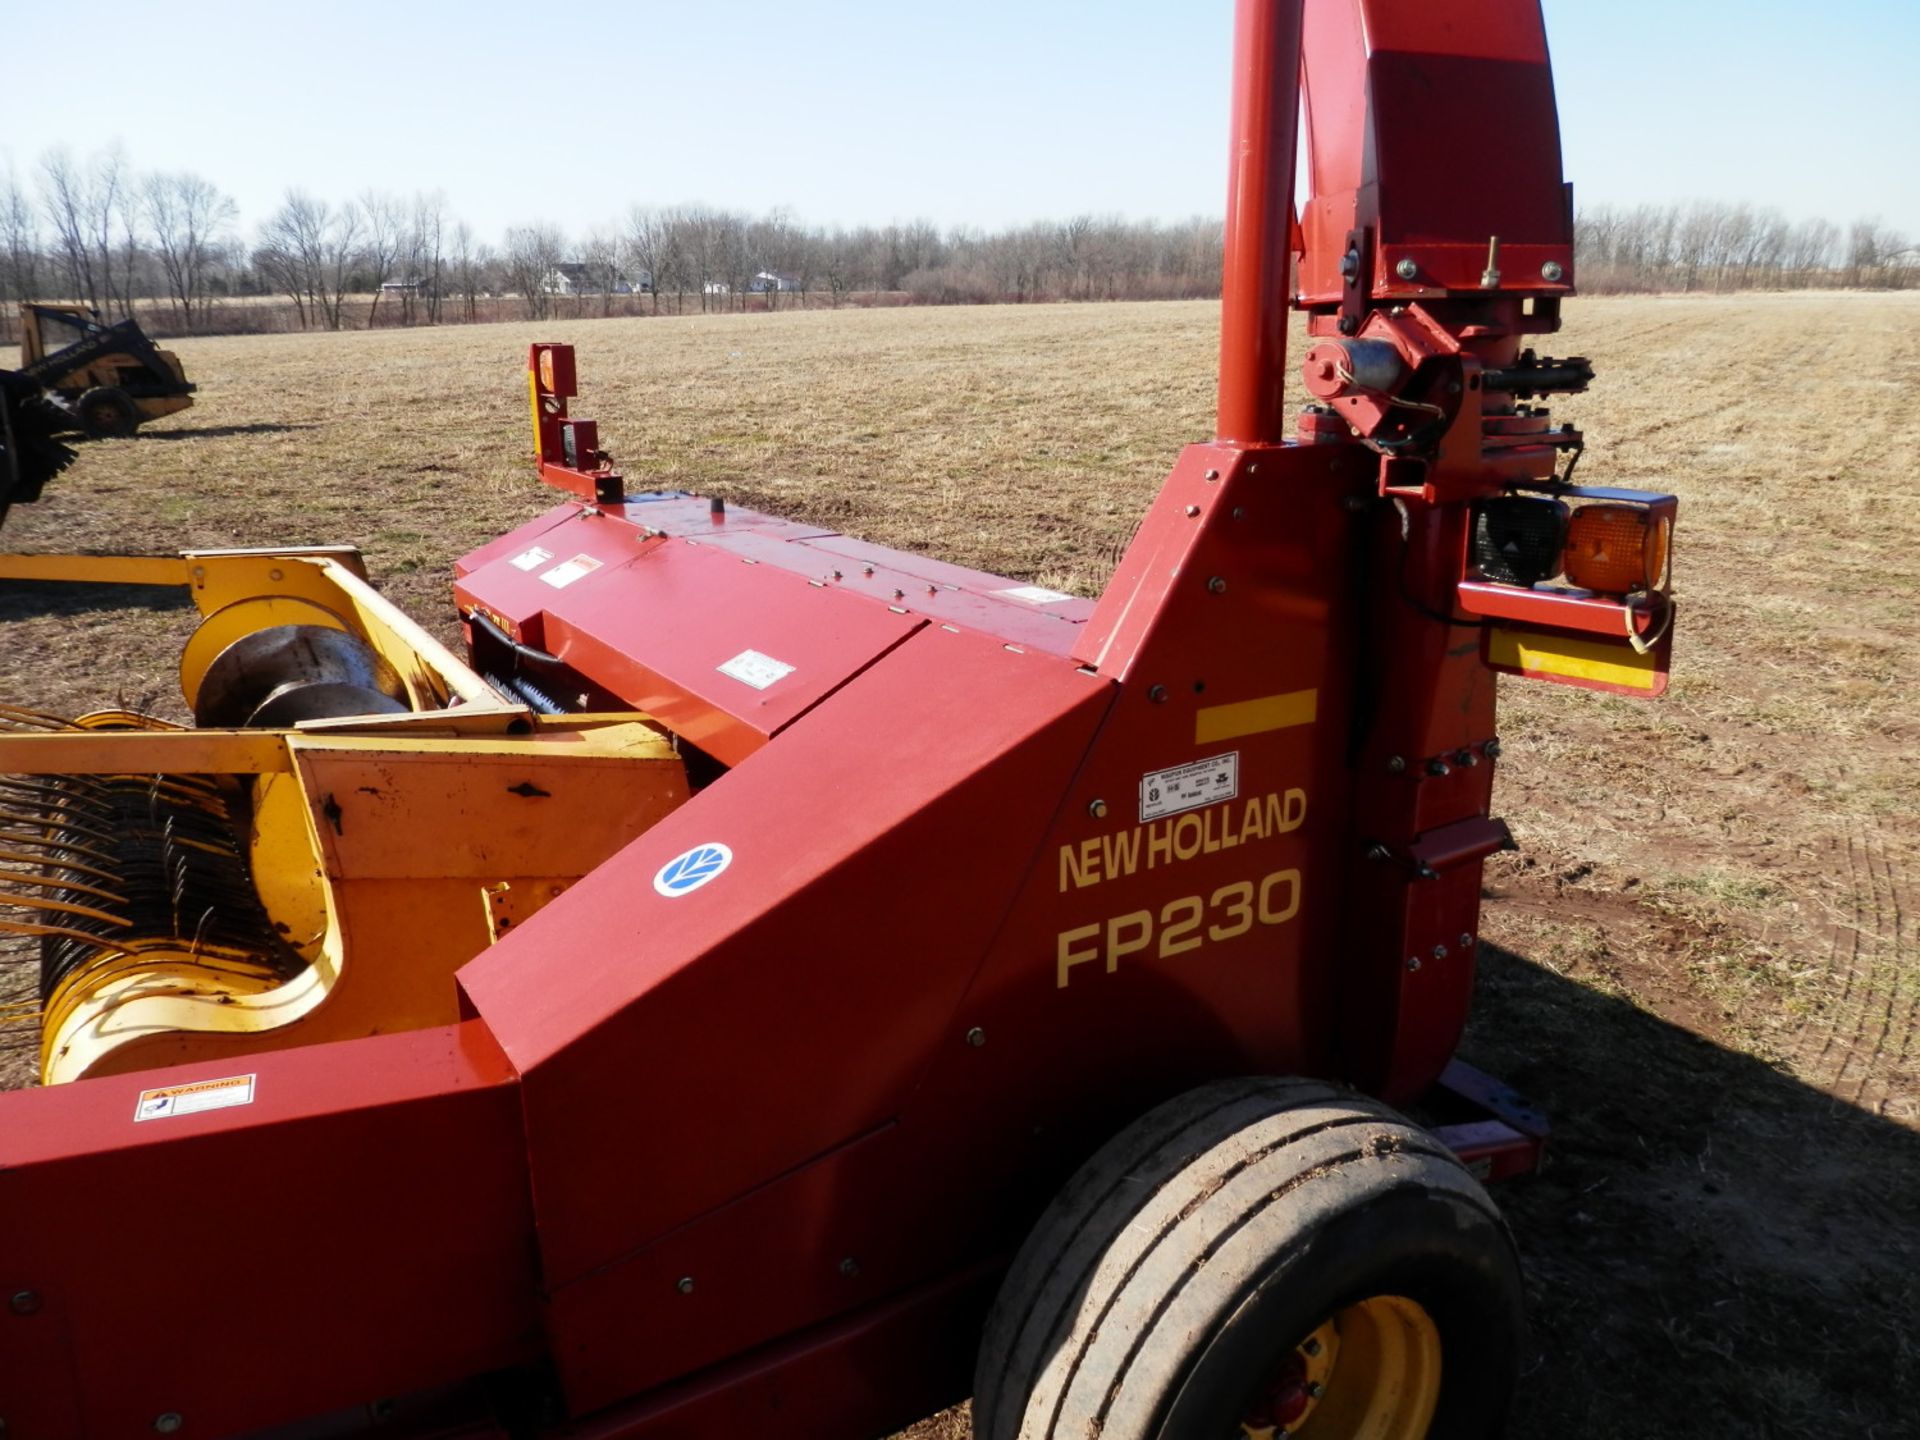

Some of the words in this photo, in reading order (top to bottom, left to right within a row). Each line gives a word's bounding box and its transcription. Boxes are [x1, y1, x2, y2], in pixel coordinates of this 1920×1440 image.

[1059, 827, 1142, 893] NEW
[1147, 787, 1307, 869] HOLLAND
[1057, 867, 1301, 989] FP230
